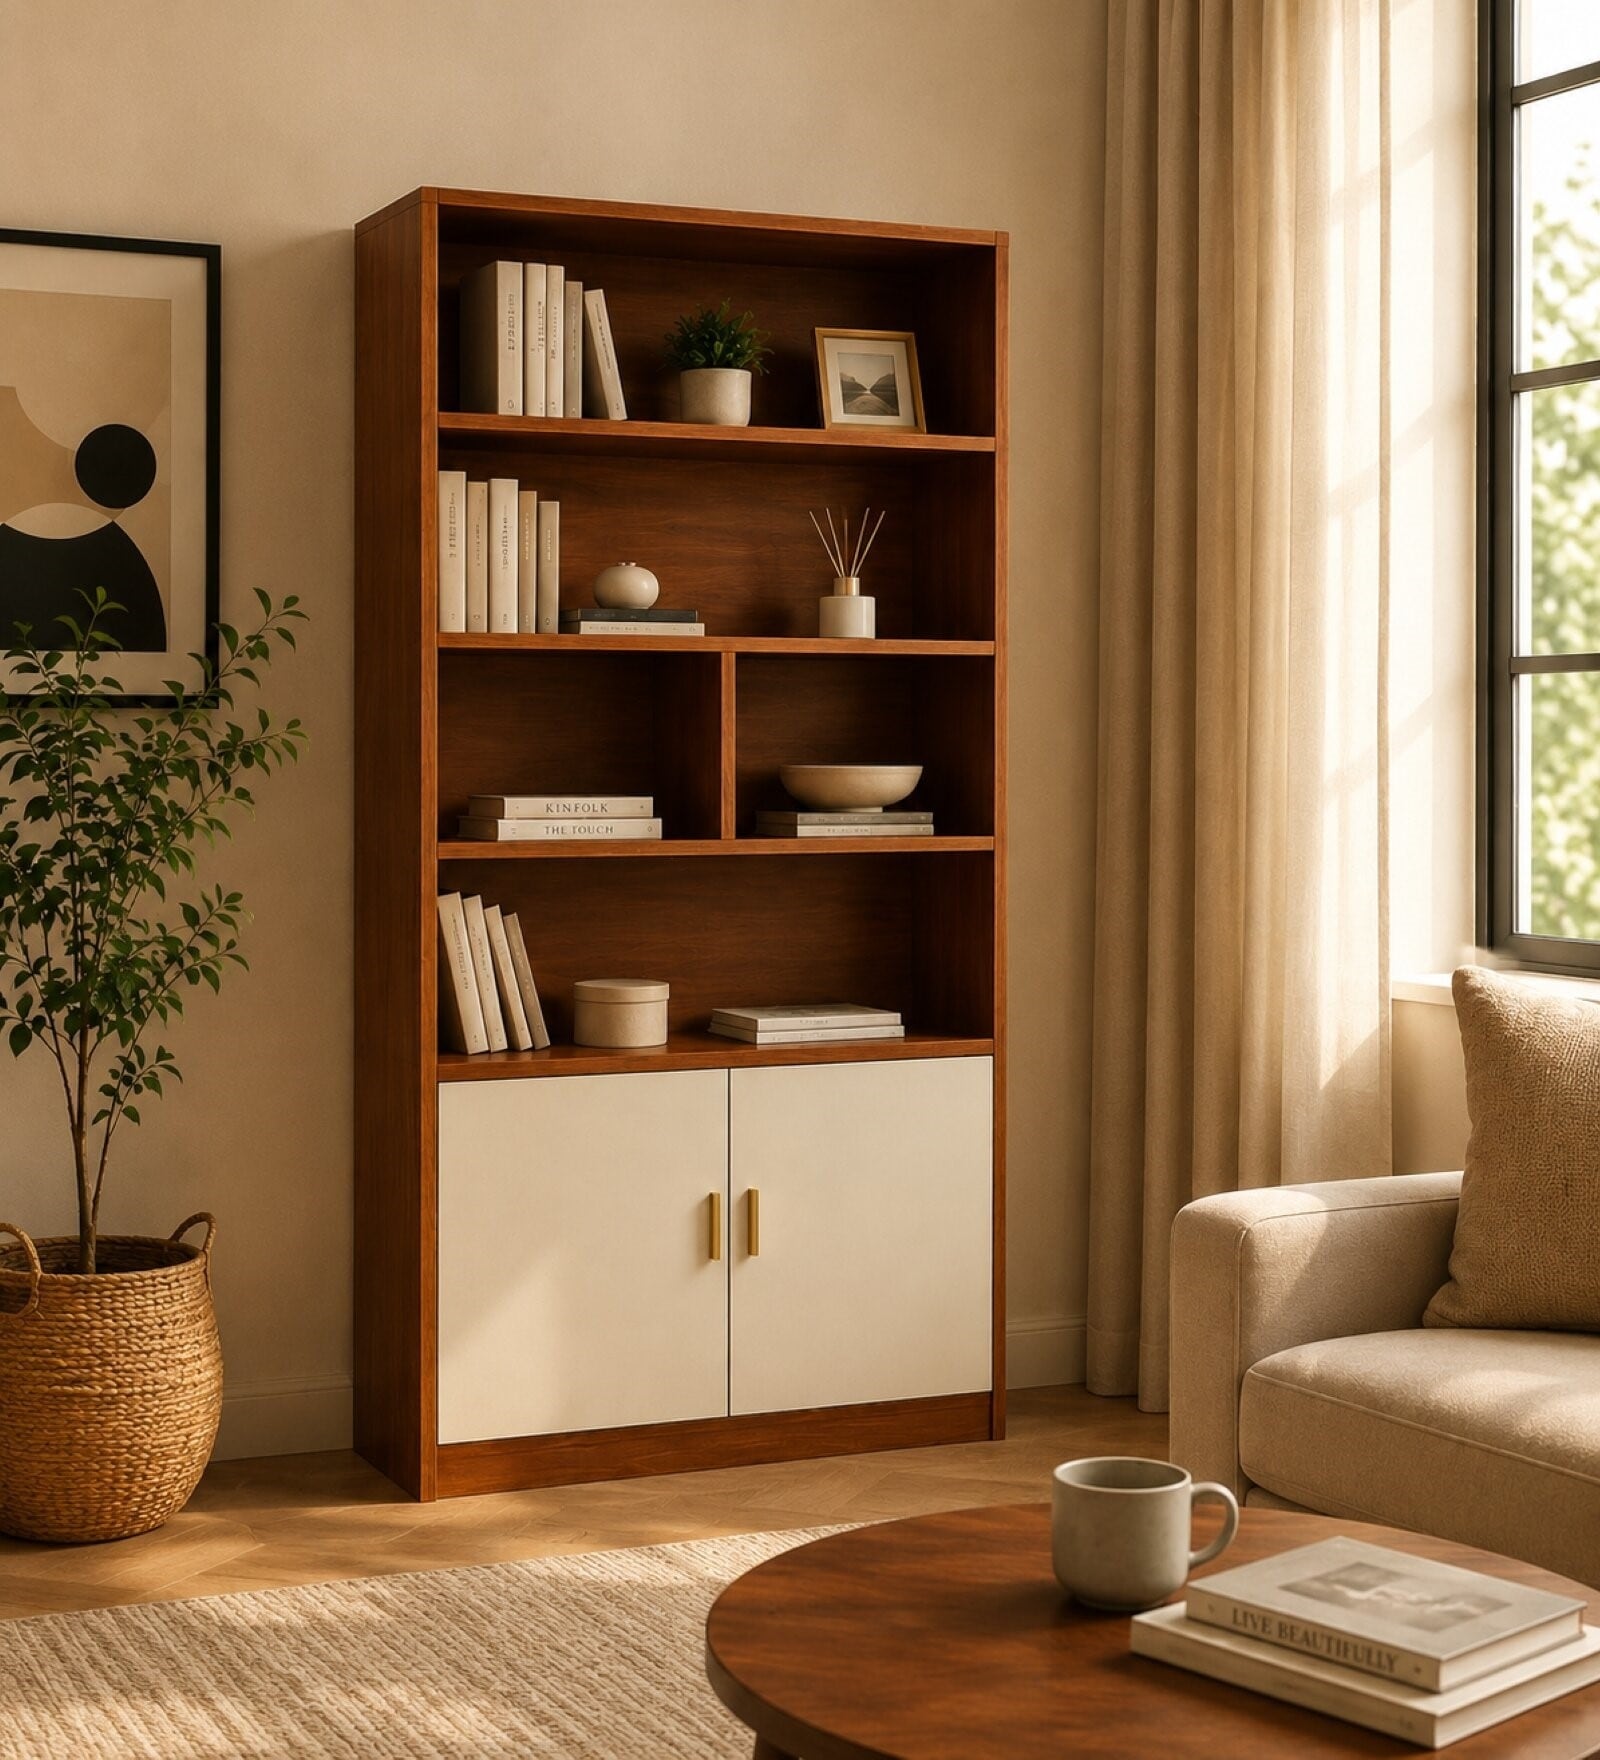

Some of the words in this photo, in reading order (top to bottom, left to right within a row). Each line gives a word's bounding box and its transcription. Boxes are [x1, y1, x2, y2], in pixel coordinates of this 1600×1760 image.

[546, 803, 608, 812] KINFOLK
[544, 826, 567, 835] THE
[572, 825, 614, 835] TOUCH
[1232, 1607, 1272, 1635] LIVE
[1278, 1621, 1398, 1673] BEAUTIFULLY
